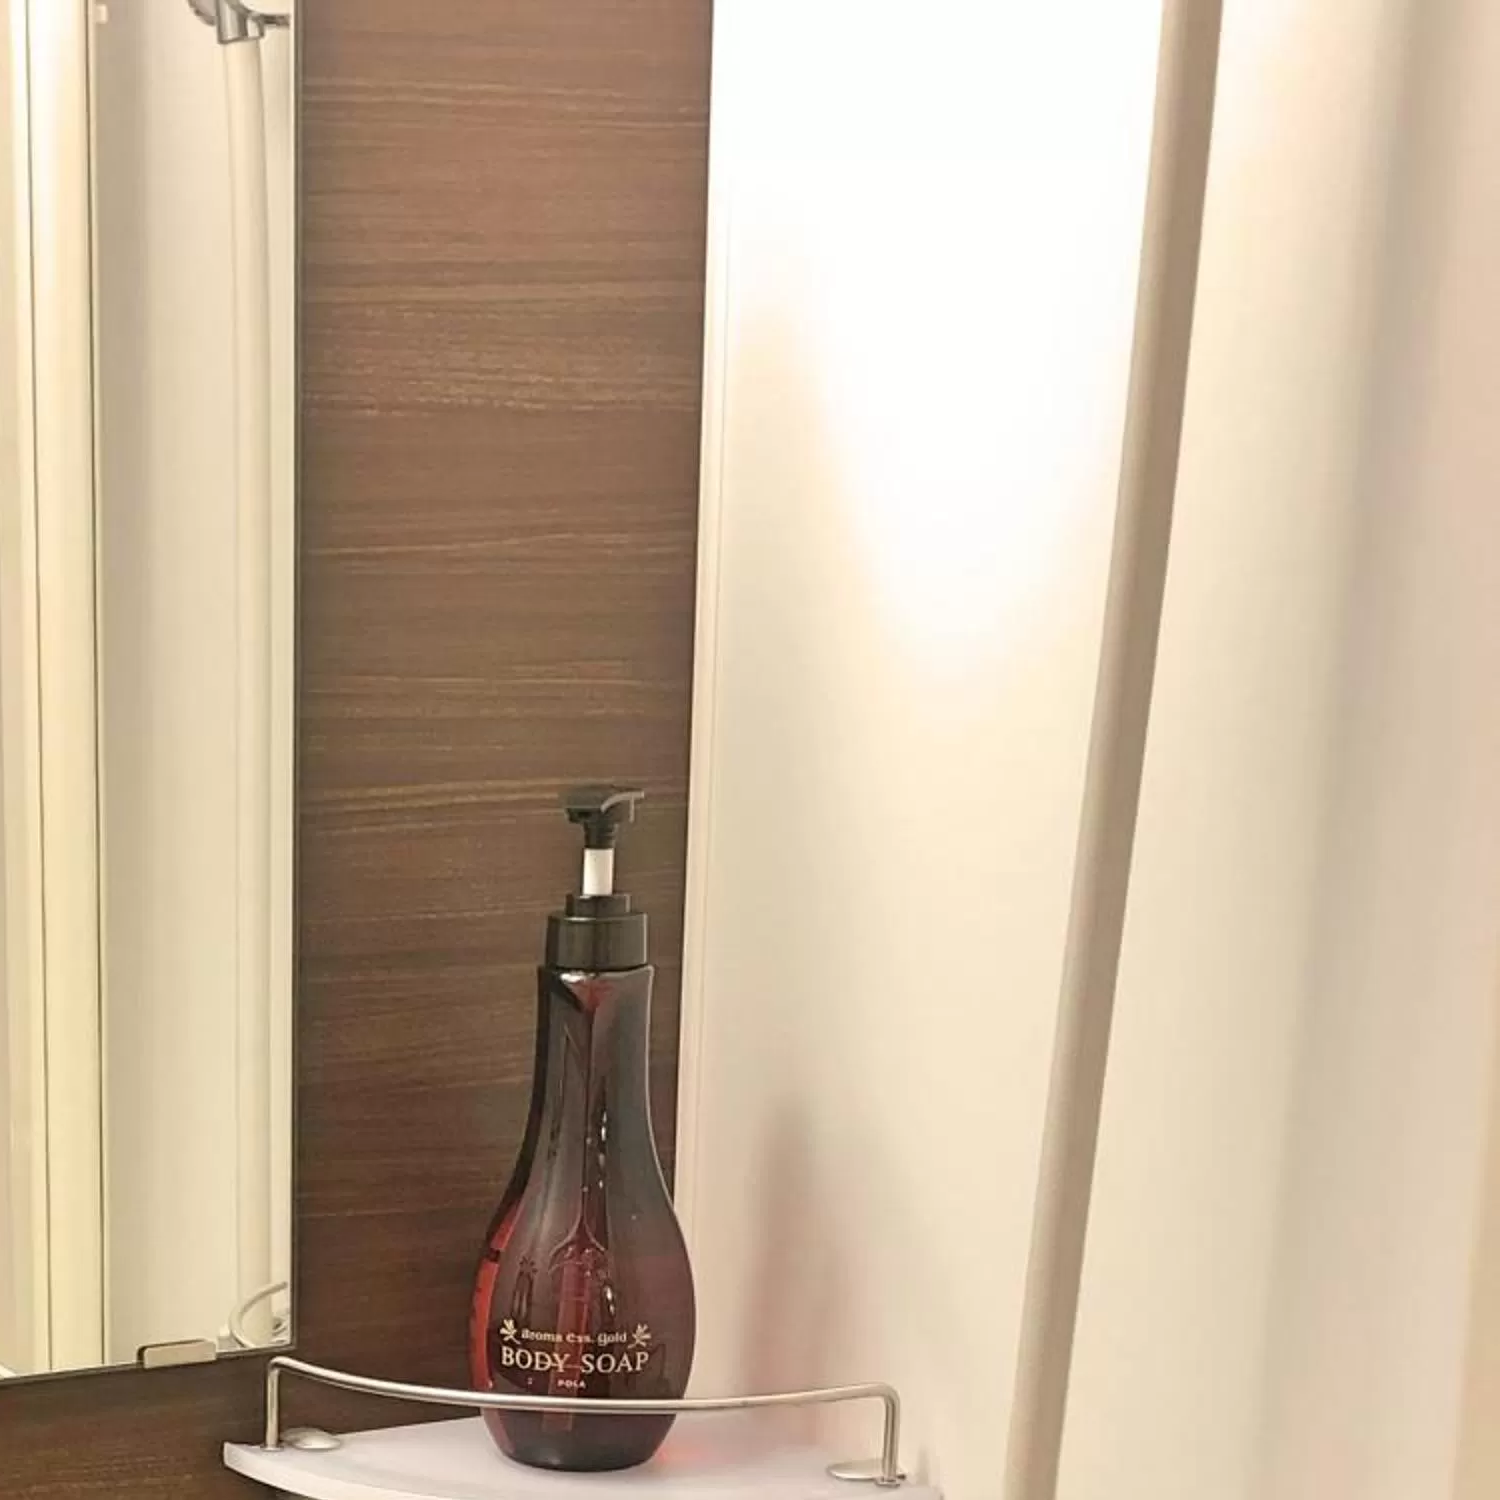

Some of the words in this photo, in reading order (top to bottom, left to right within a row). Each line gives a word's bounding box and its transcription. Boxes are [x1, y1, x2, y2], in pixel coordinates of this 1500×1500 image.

[598, 1331, 628, 1347] gold
[501, 1345, 571, 1373] BODY
[580, 1350, 649, 1374] SOAP
